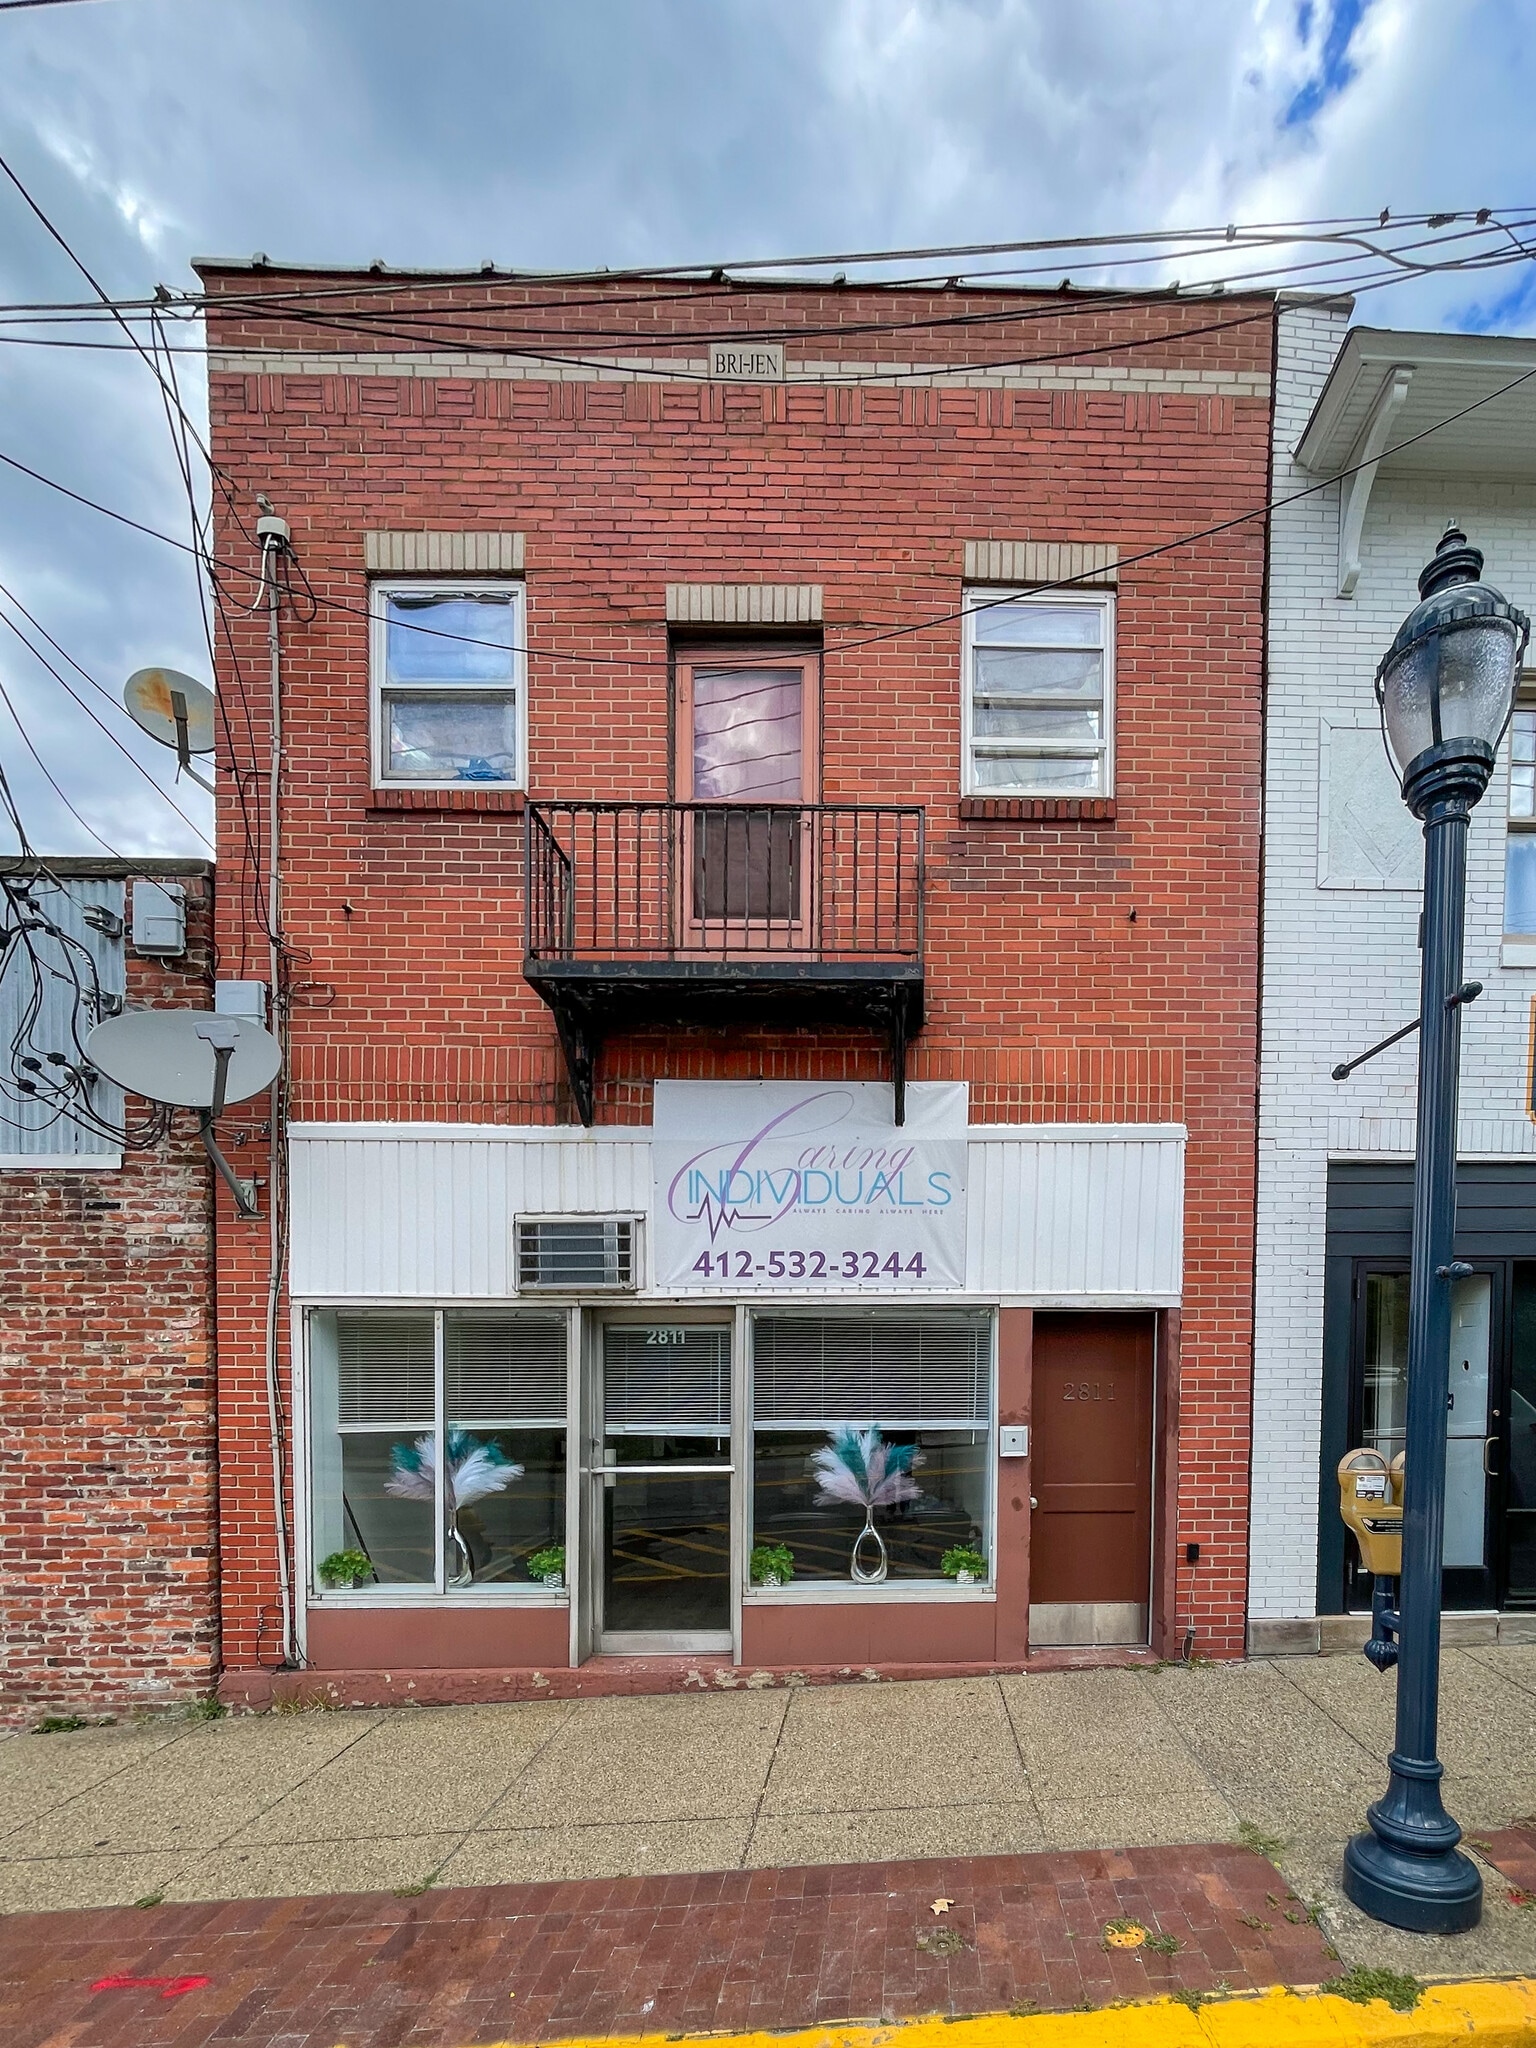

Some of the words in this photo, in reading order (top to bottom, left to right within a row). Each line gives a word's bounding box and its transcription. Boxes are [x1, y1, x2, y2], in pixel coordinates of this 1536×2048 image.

[715, 353, 778, 375] BRI-JEN
[667, 1090, 916, 1232] Caring
[688, 1169, 952, 1206] INDIVIDUALS
[692, 1250, 927, 1279] 412-532-3244
[646, 1329, 686, 1345] 2811
[1062, 1382, 1117, 1401] 2811
